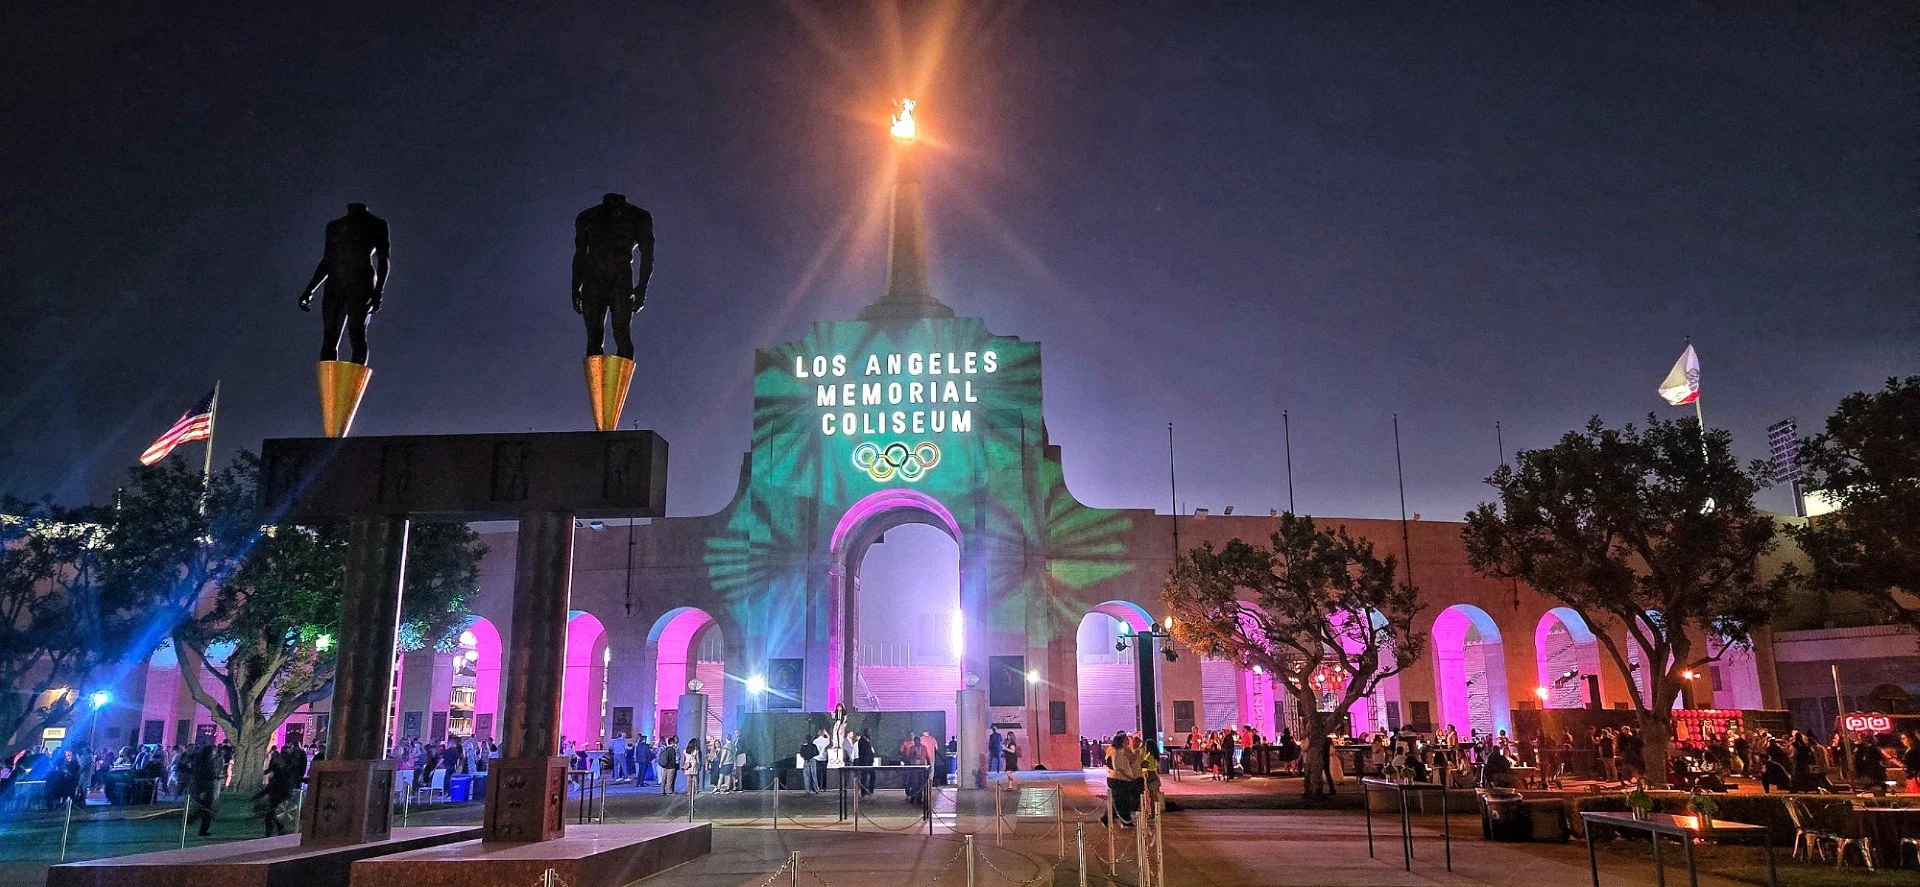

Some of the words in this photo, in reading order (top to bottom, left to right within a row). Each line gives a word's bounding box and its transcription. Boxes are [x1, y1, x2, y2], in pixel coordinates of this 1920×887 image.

[796, 354, 847, 378] LOS
[865, 350, 998, 376] ANGELES
[816, 380, 978, 407] MEMORIAL
[822, 409, 972, 436] COLISEUM
